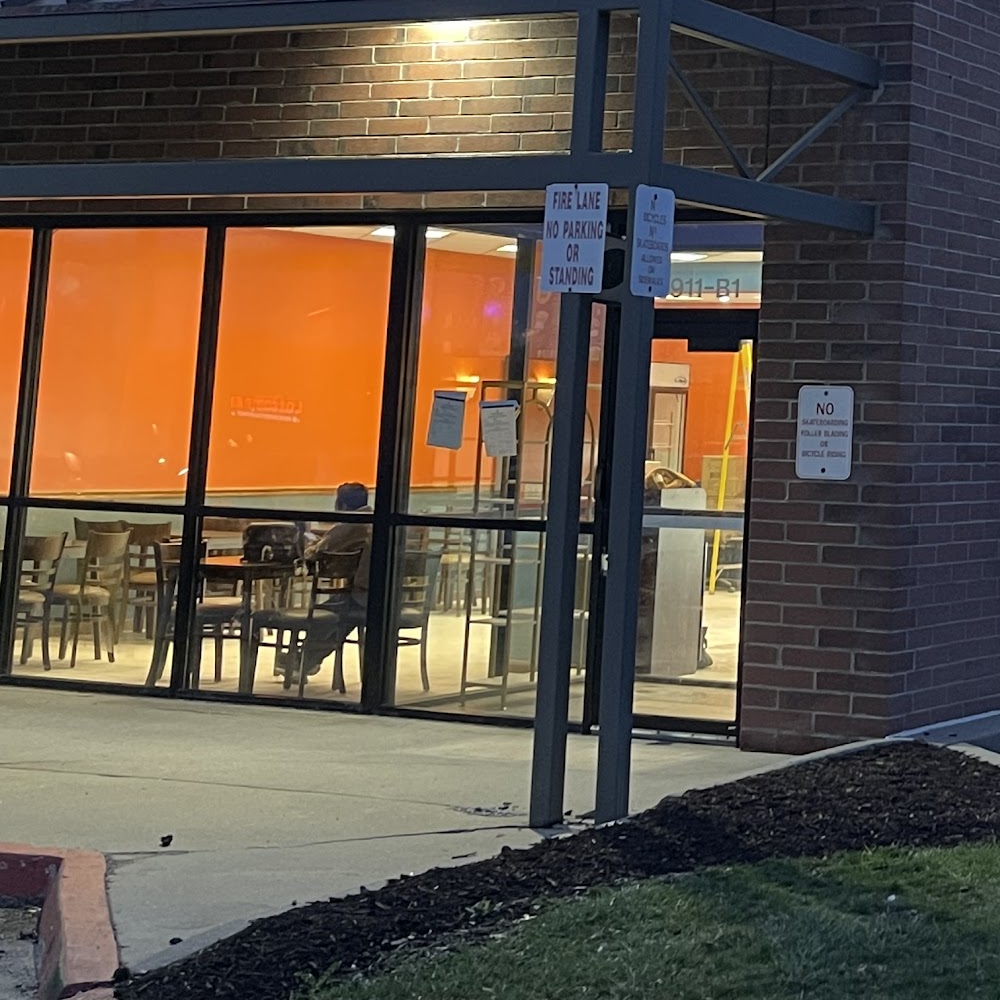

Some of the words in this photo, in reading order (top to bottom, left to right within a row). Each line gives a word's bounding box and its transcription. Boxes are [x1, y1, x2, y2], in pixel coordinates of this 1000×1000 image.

[552, 191, 573, 210] FIRE
[576, 191, 601, 210] LANE
[545, 220, 559, 239] NO
[562, 220, 604, 240] PARKING
[566, 243, 580, 262] OR
[548, 266, 594, 286] STANDING
[816, 402, 834, 415] NO
